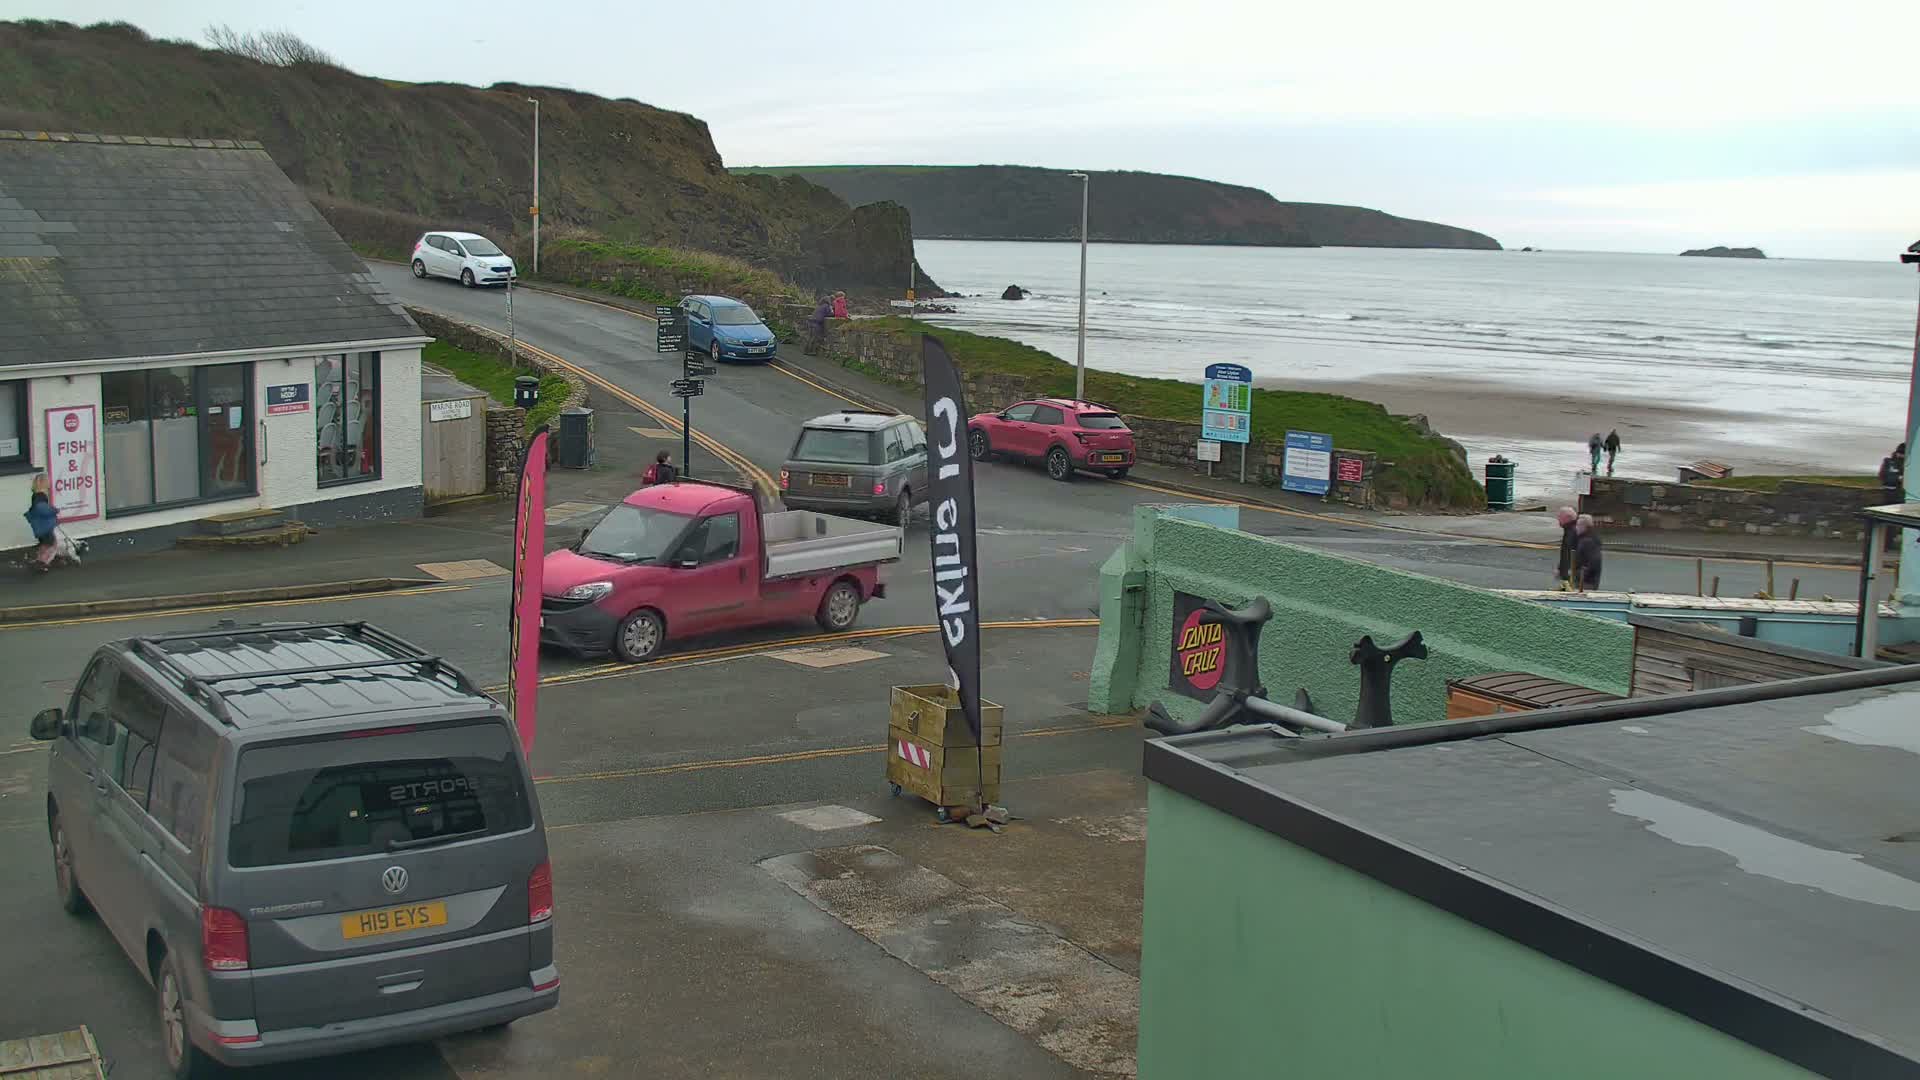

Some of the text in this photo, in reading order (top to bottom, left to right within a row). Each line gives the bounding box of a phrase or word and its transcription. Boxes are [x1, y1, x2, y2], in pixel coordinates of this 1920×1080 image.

[454, 400, 470, 409] ROAD
[57, 440, 87, 456] FISH
[68, 460, 78, 472] &
[55, 475, 93, 491] CHIPS
[1177, 623, 1222, 651] SANTA
[1183, 647, 1220, 676] CRUZ
[359, 906, 430, 934] H19 EYS
